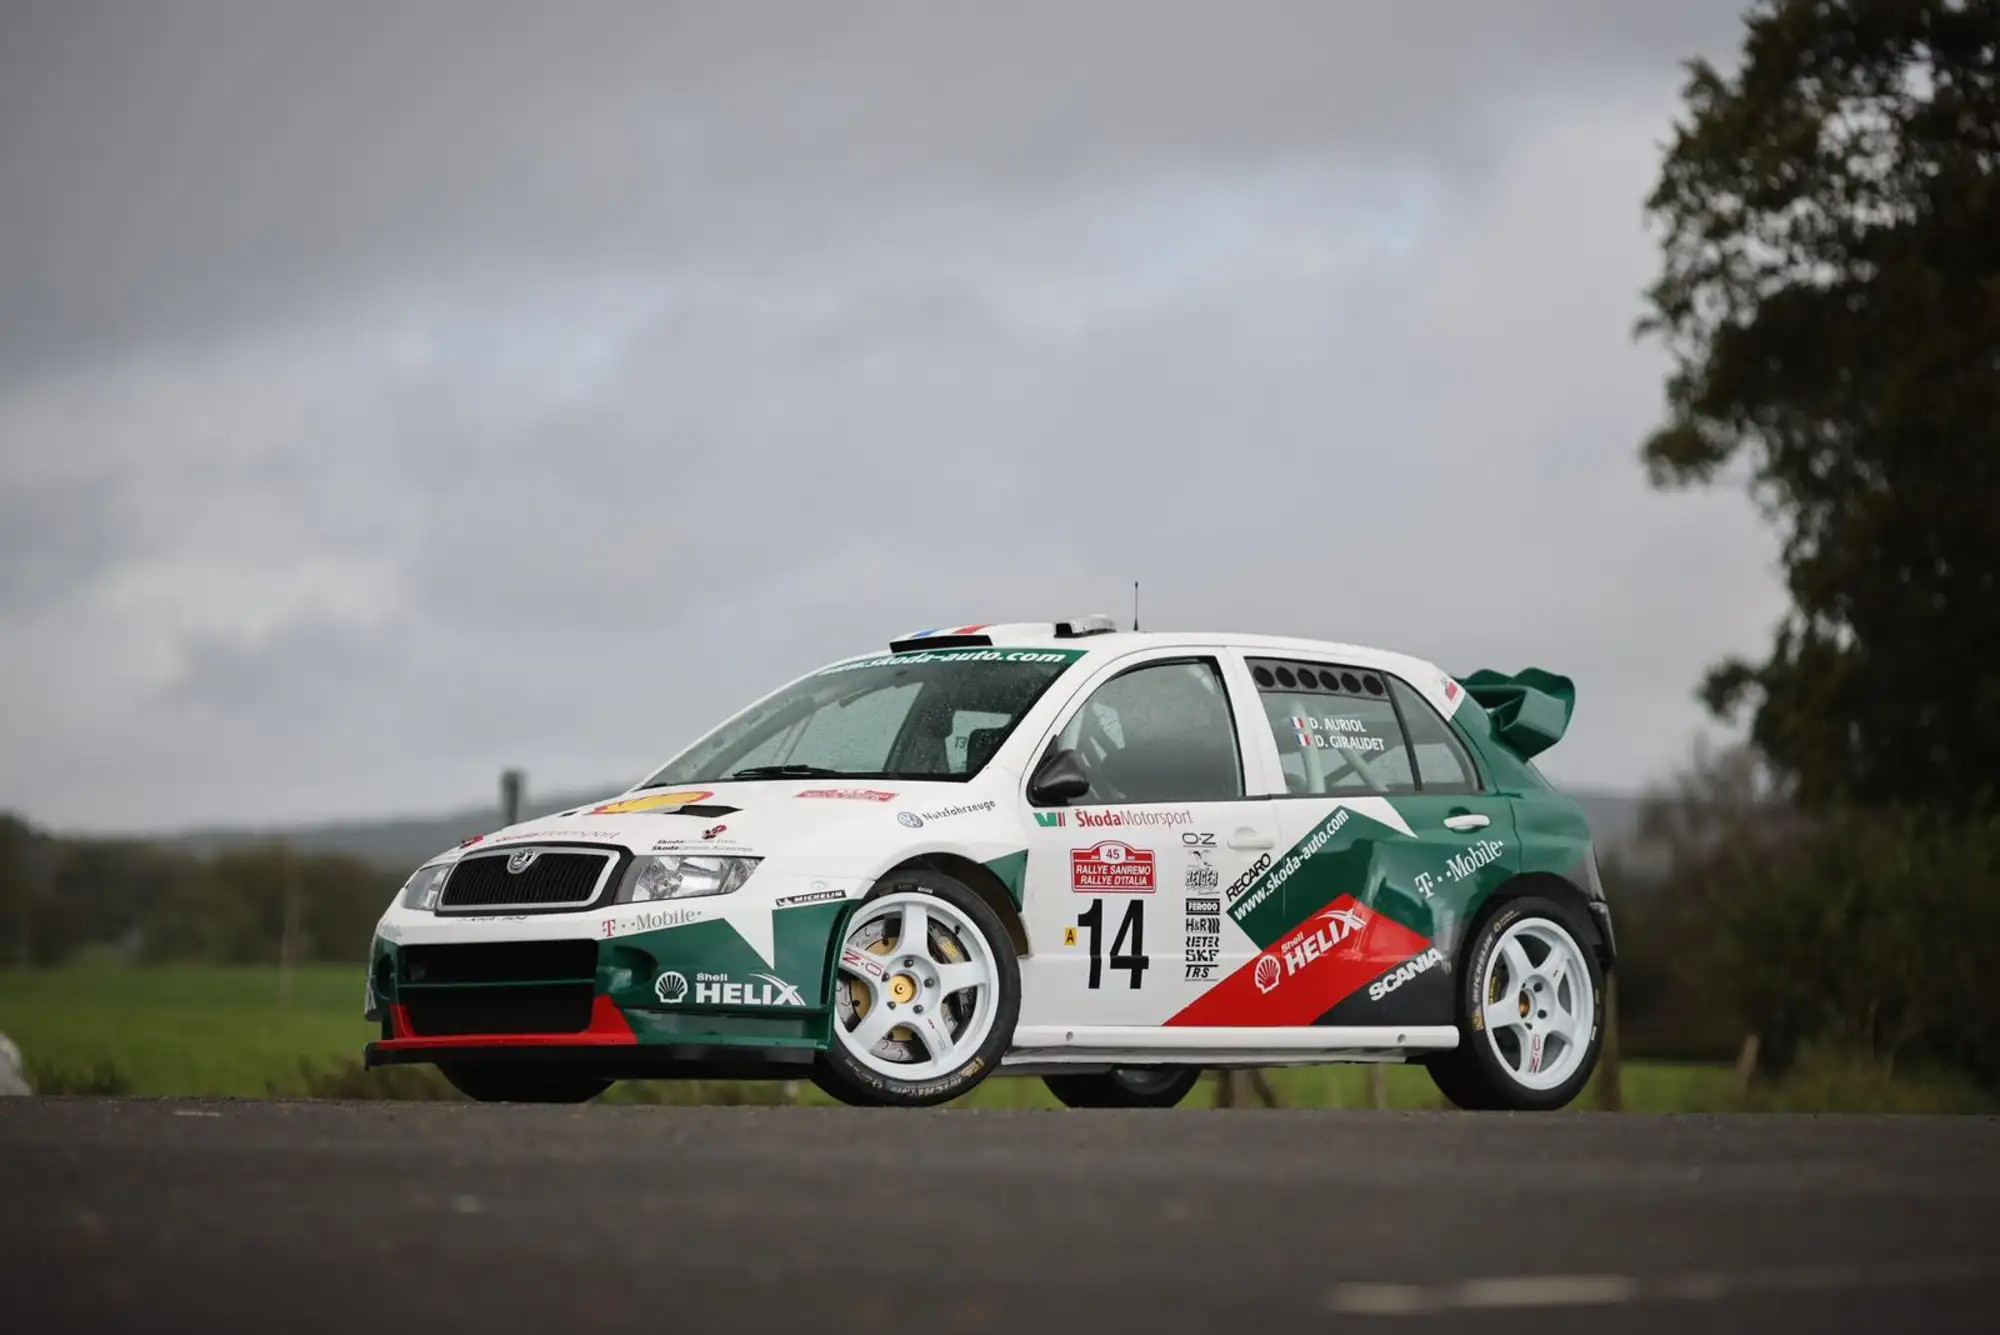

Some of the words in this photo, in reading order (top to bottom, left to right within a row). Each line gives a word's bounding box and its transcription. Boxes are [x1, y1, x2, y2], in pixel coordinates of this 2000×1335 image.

[1308, 717, 1323, 730] D.
[1324, 718, 1367, 733] AURIOL
[1314, 734, 1329, 748] D.
[1329, 735, 1385, 751] GIRAUDET
[922, 799, 996, 822] Nutzfahrzeuge
[1105, 849, 1120, 860] 45
[1076, 864, 1109, 875] RALLYE
[1109, 865, 1151, 876] SANREMO
[1234, 809, 1350, 921] www.skoda-auto.com
[1080, 875, 1112, 886] RALLYE
[1114, 876, 1147, 886] D'ITALIA
[1225, 852, 1272, 902] RECARO
[794, 891, 842, 903] MICHELIN
[1066, 929, 1075, 944] A
[1077, 898, 1149, 990] 14
[1281, 931, 1304, 953] Shell
[1282, 908, 1366, 977] HELIX
[1185, 949, 1220, 962] SKF
[696, 972, 728, 982] Shell
[1185, 964, 1219, 979] TRS
[1368, 947, 1444, 1001] SCANIA
[695, 973, 807, 1007] HELIX
